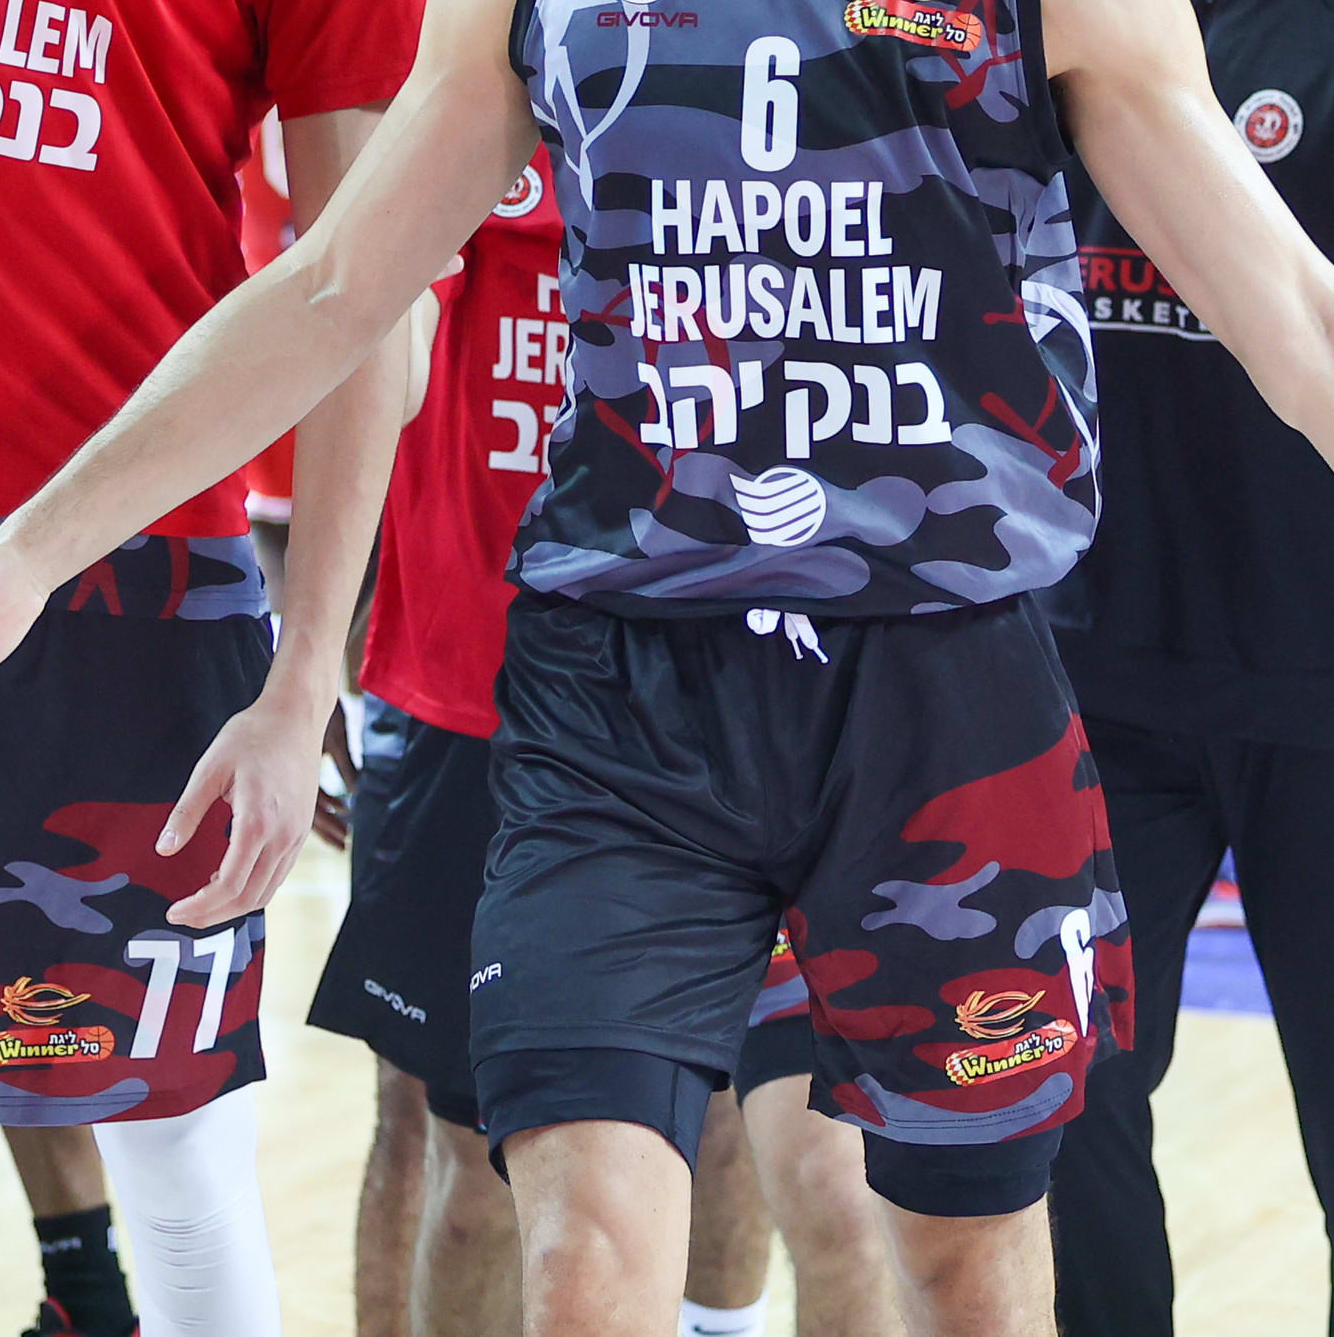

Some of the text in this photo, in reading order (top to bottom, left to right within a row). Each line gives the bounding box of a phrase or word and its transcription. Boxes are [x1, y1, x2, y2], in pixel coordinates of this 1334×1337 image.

[596, 11, 699, 28] GIVOVA
[860, 6, 966, 42] Winner סל
[913, 11, 944, 27] ליגת
[740, 35, 801, 172] 6
[651, 178, 894, 258] HAPOEL
[628, 262, 943, 345] JERUSALEM
[637, 359, 765, 450] יהב
[783, 359, 953, 460] בנק
[128, 926, 236, 1059] 77
[470, 962, 502, 995] OVA
[1060, 908, 1095, 1038] 6
[364, 978, 427, 1024] GIVOVA
[48, 1032, 77, 1046] ליגת
[80, 1038, 100, 1055] סל
[961, 1036, 1064, 1078] Winner סל
[1014, 1033, 1042, 1055] ליגת
